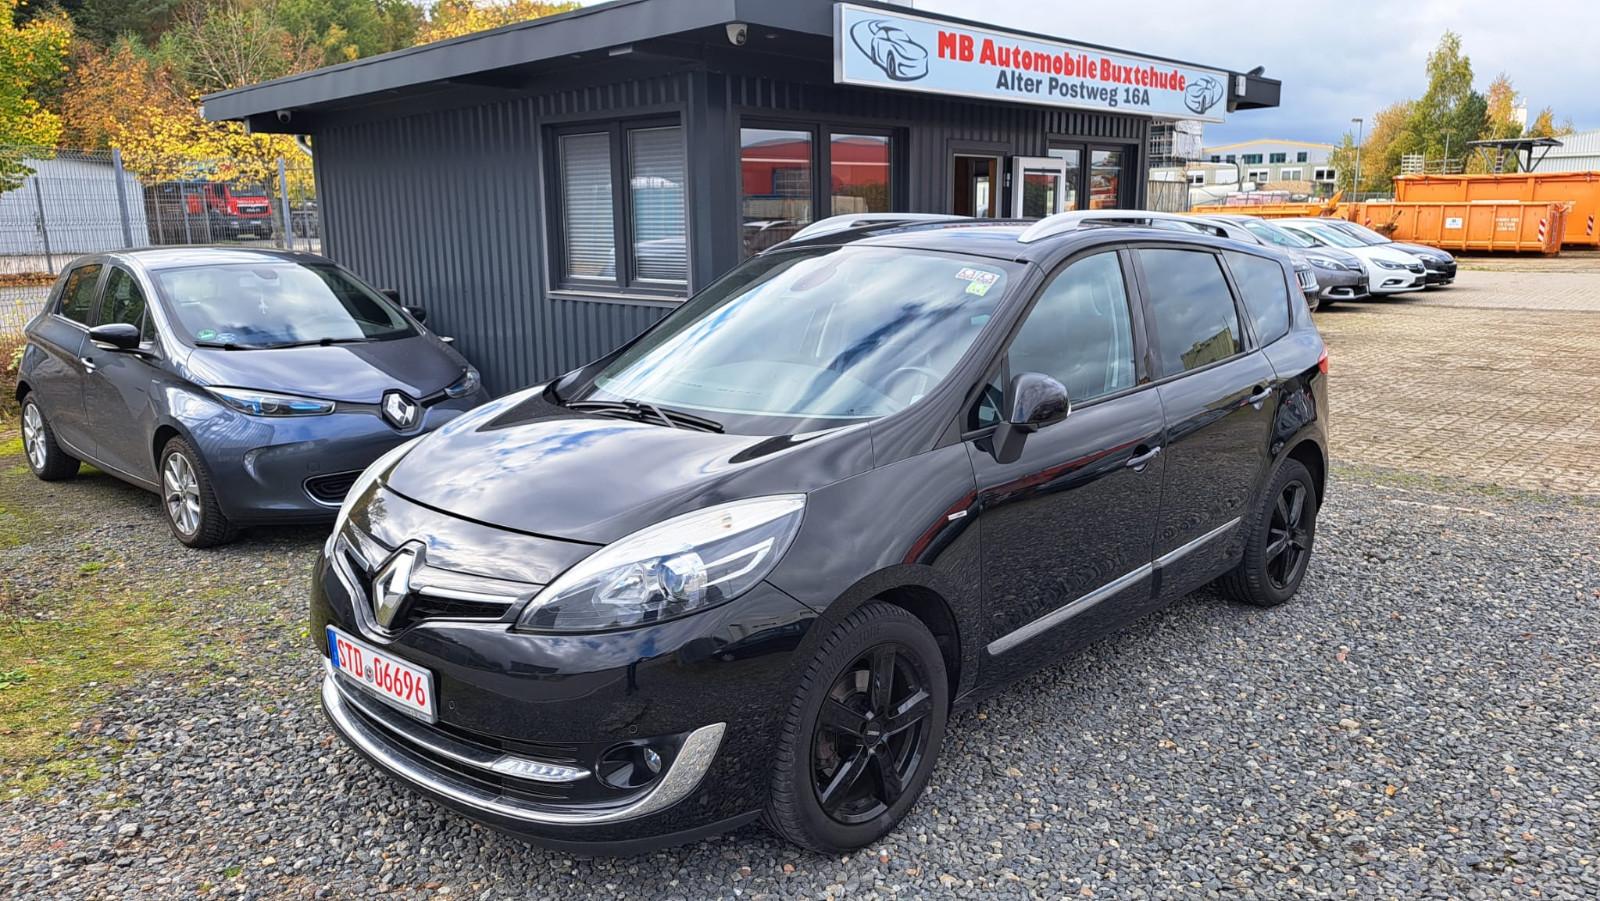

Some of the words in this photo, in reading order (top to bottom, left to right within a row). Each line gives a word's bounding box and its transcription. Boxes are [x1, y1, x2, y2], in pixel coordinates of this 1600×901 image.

[938, 31, 975, 62] MB
[979, 39, 1097, 79] Automobile
[1099, 58, 1185, 91] Buxtehude
[997, 69, 1044, 95] Alter
[1048, 76, 1119, 107] Postweg
[1122, 86, 1150, 106] 16A
[337, 639, 364, 678] STD
[373, 656, 426, 707] 06696
